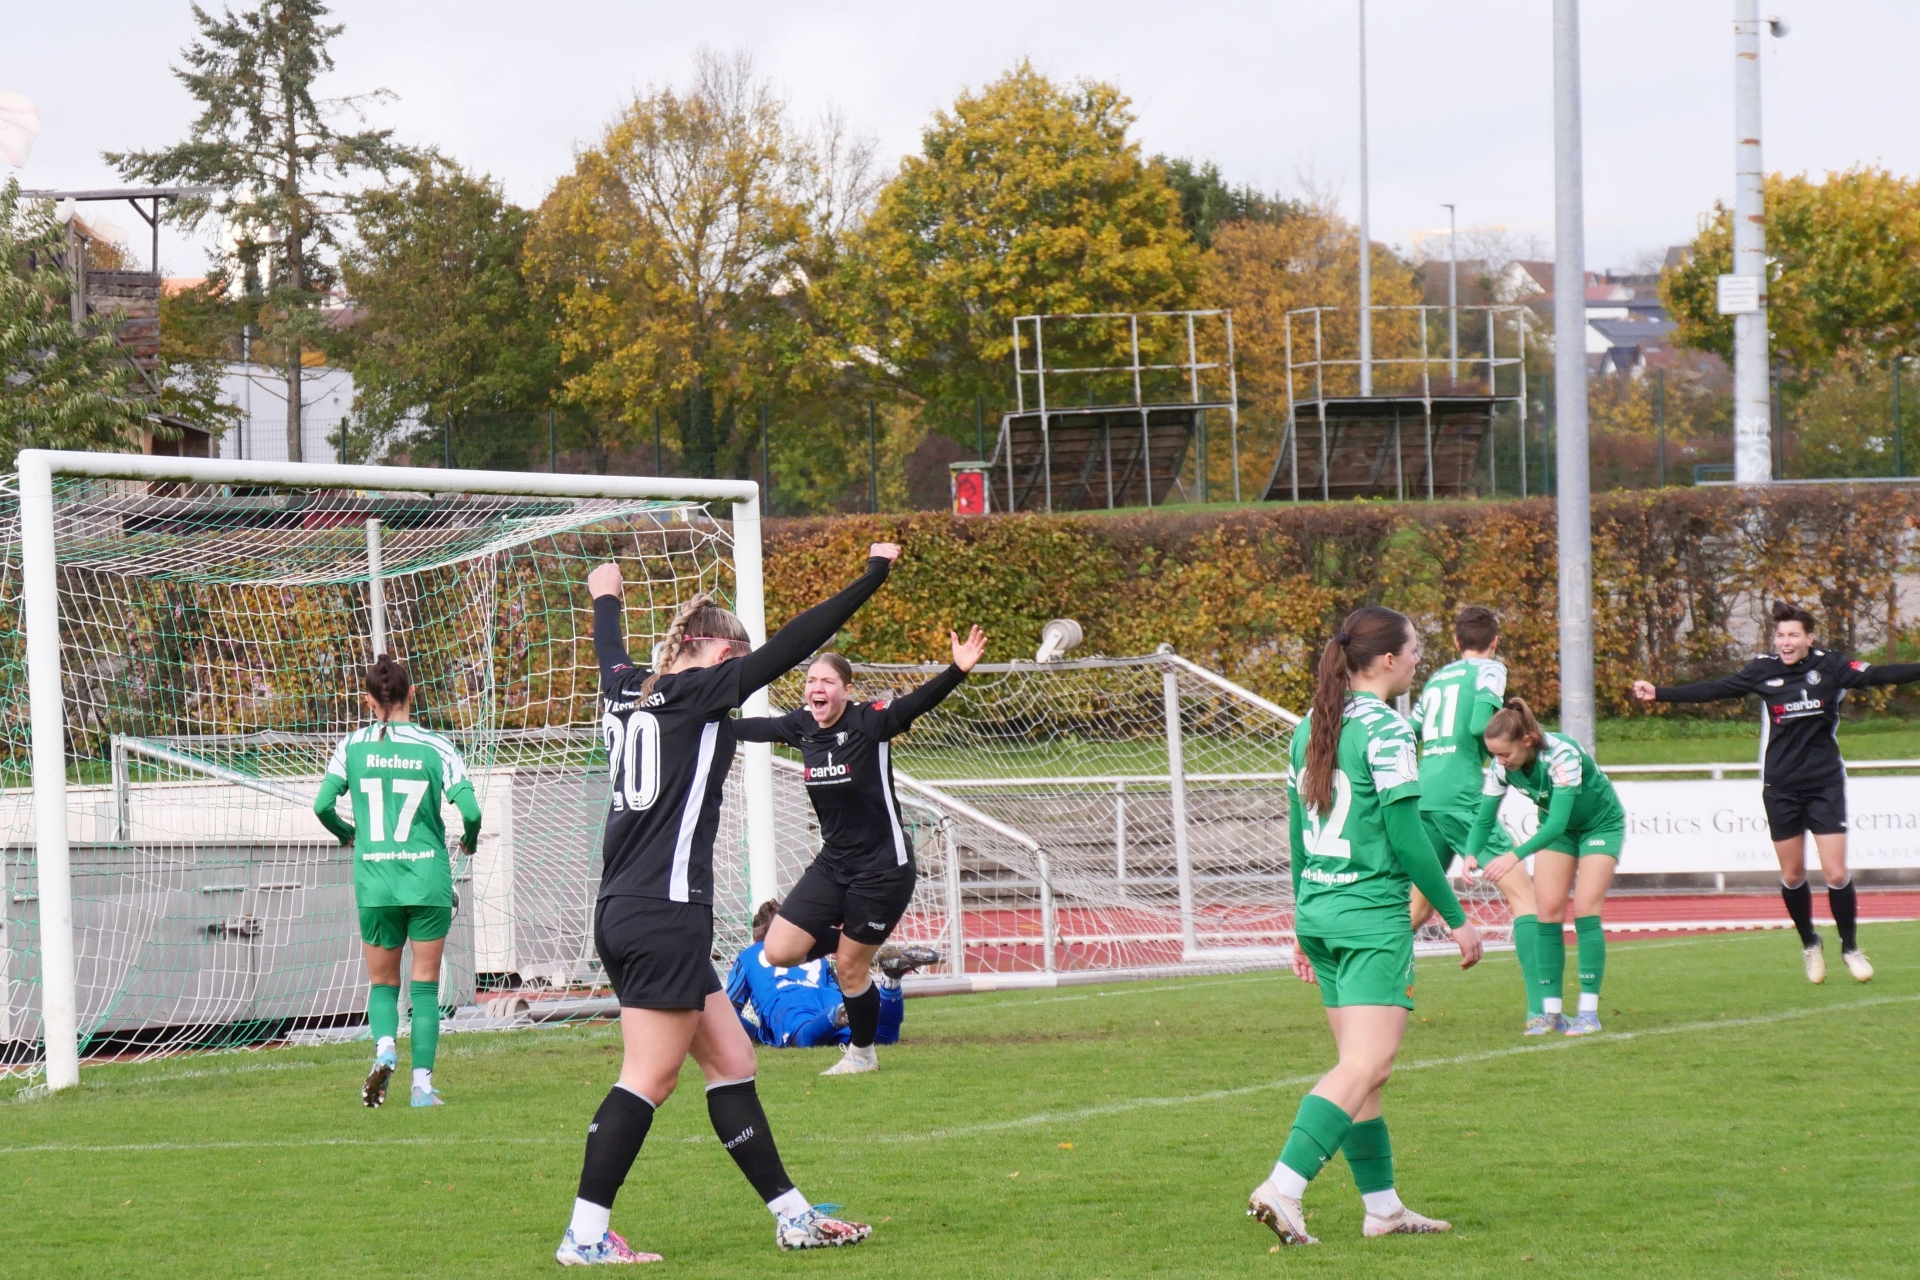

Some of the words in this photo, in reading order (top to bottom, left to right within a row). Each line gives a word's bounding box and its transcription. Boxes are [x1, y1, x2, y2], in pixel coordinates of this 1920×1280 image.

[1422, 684, 1460, 742] 21
[366, 754, 423, 770] Riechers
[602, 711, 661, 811] 20
[360, 778, 430, 842] 17
[1629, 811, 1701, 834] istics
[1713, 808, 1768, 833] Gro
[362, 849, 434, 862] magnet-shop.net
[1736, 850, 1774, 861] MEM
